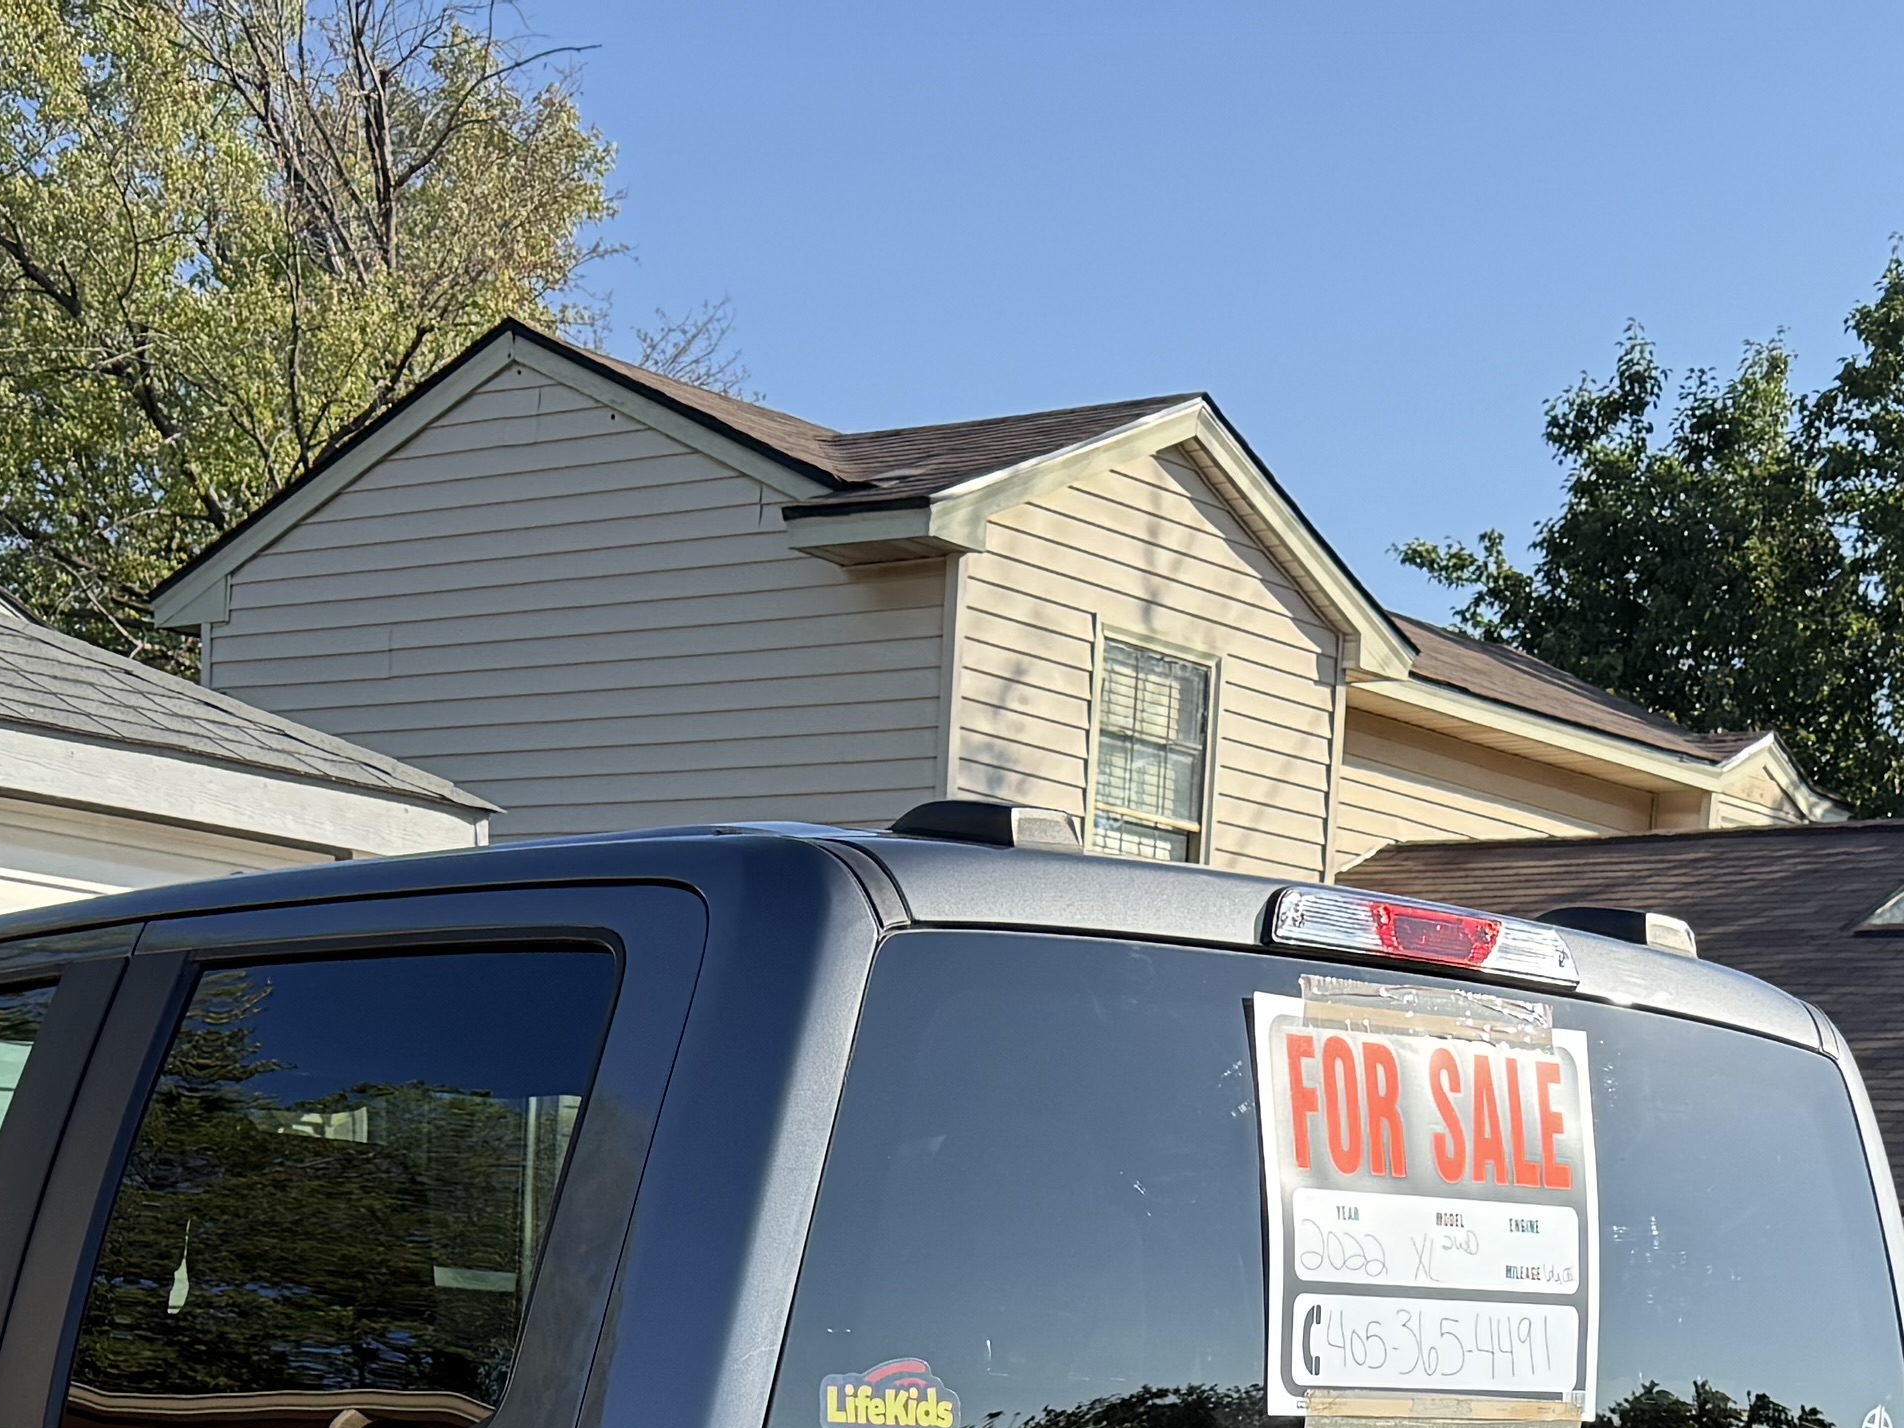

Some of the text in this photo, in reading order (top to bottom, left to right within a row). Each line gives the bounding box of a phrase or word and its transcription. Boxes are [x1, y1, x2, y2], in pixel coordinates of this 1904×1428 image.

[1285, 1032, 1573, 1191] FOR SALE
[1336, 1205, 1540, 1235] YEAR MODEL ENGINE
[1299, 1217, 1389, 1278] 2022
[1409, 1232, 1441, 1283] XL
[1505, 1264, 1542, 1282] MILEAGE
[1325, 1308, 1551, 1381] 405-365-4491
[826, 1383, 954, 1428] LifeKids
